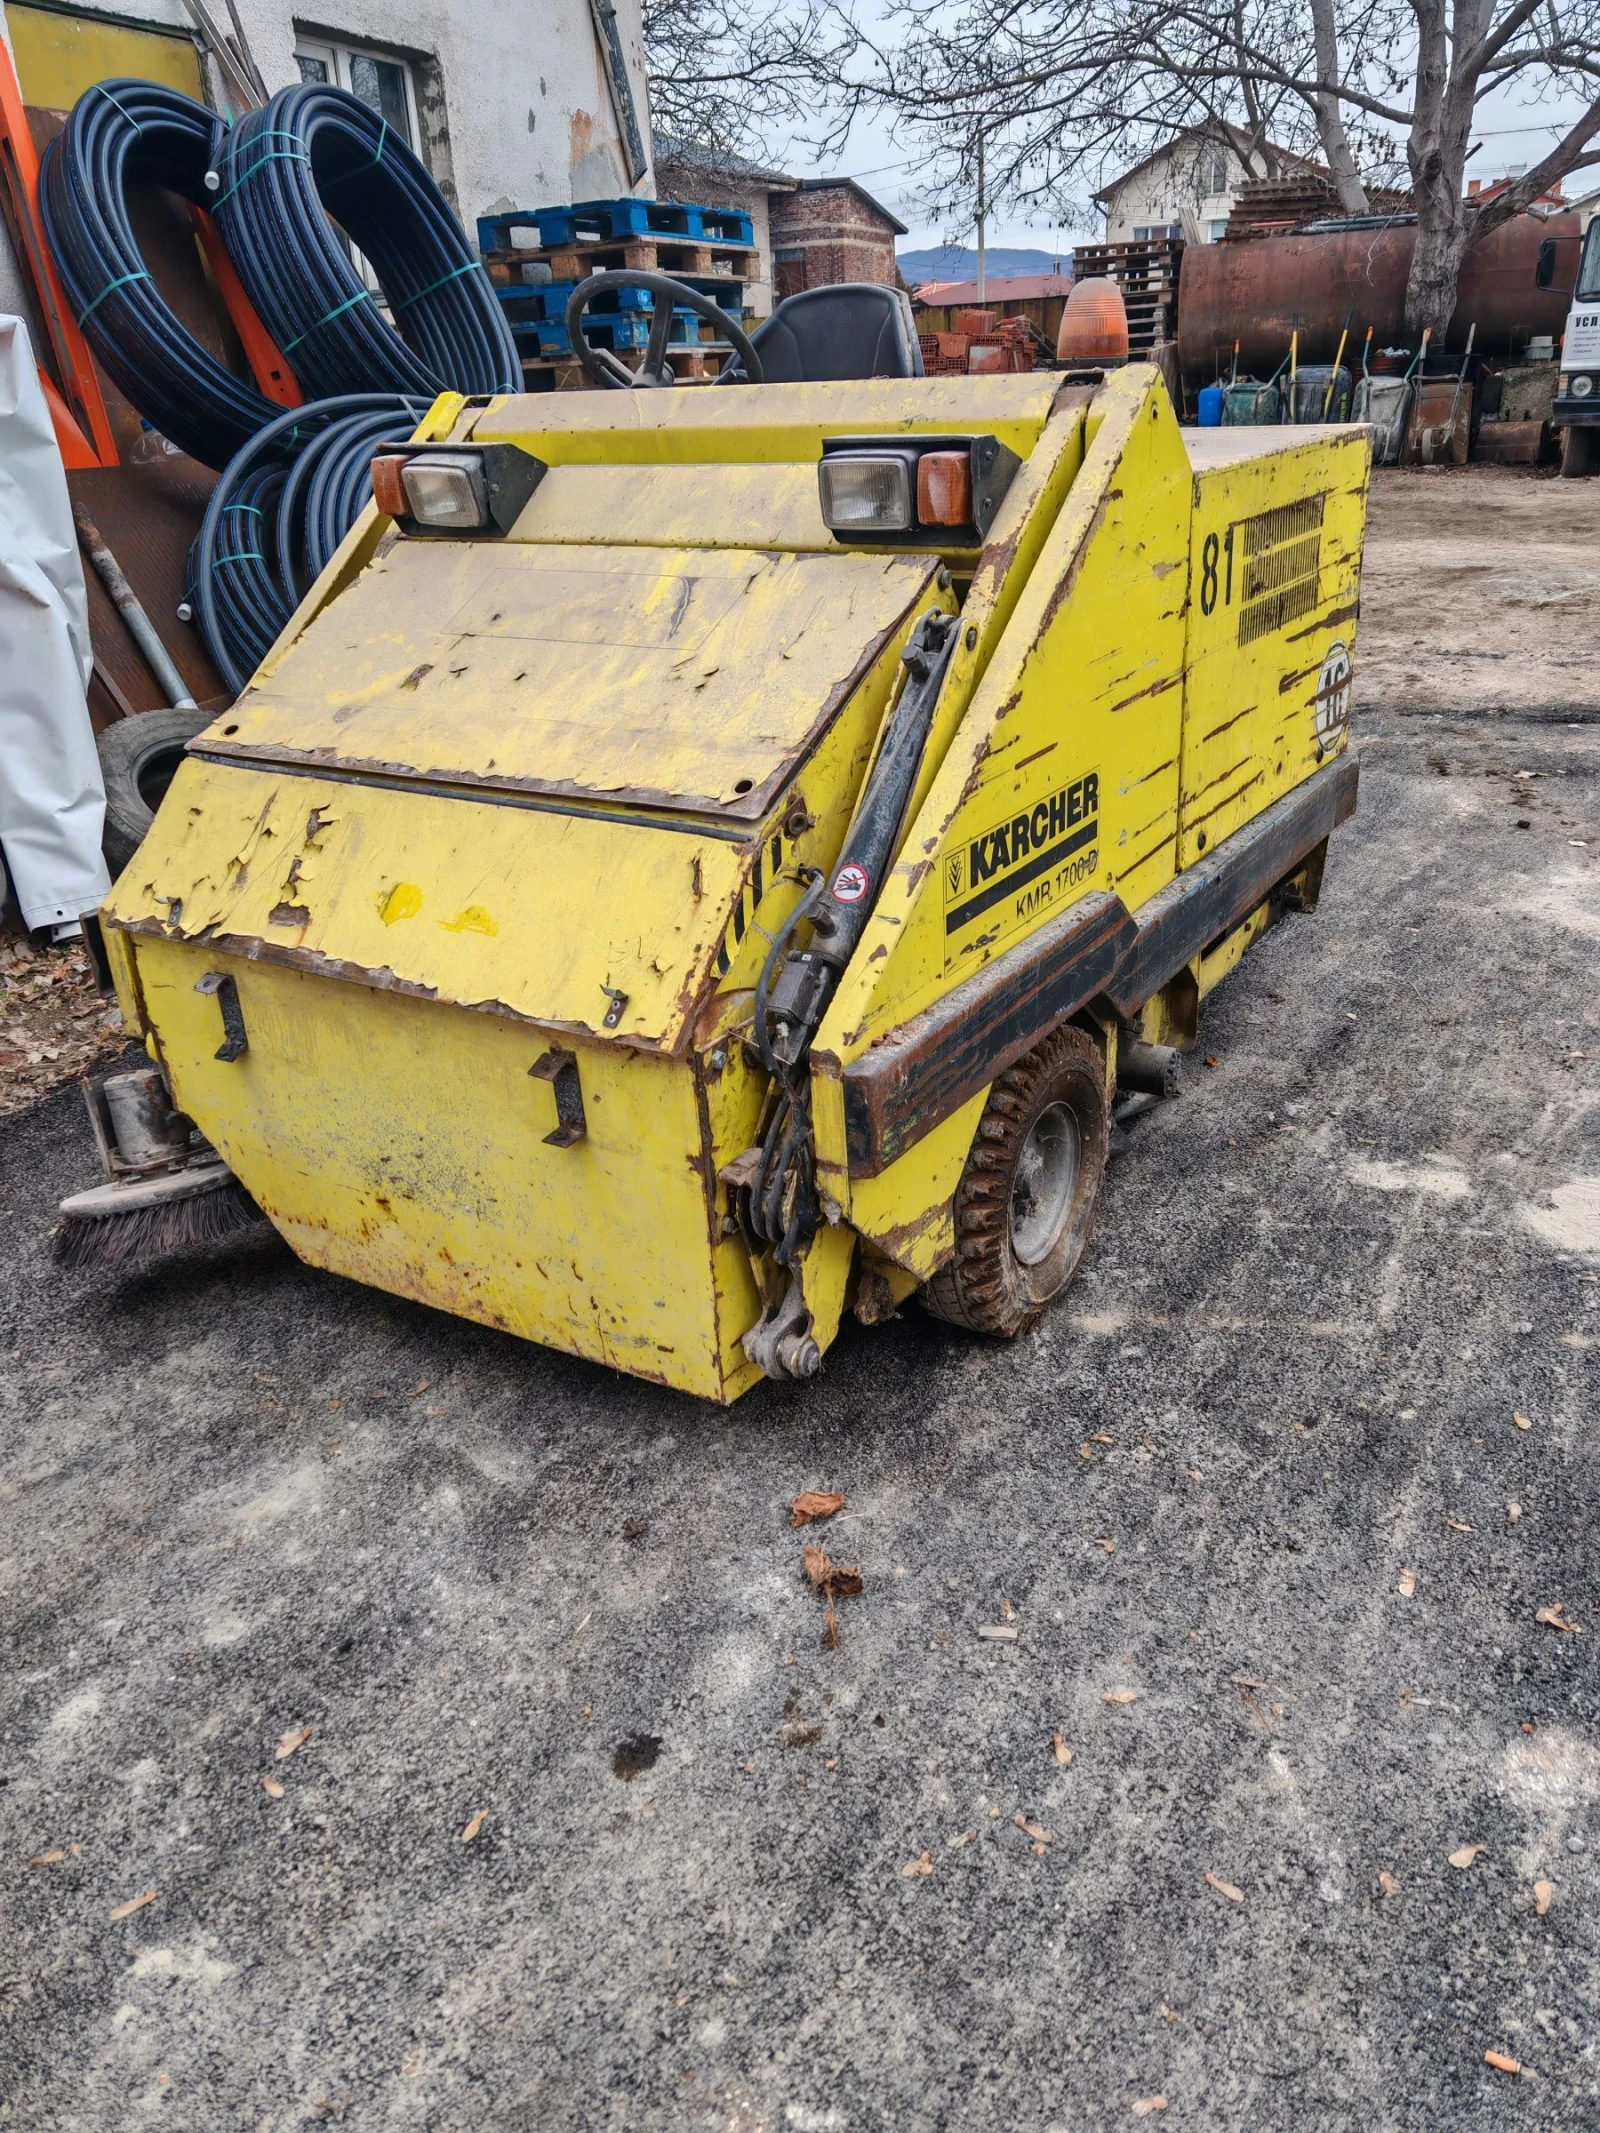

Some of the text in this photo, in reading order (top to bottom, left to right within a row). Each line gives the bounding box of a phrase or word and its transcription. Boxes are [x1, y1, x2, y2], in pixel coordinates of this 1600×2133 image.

[1575, 316, 1600, 327] УСЛ
[1201, 525, 1234, 616] 81
[970, 772, 1099, 889] KÄRCHER
[1016, 880, 1053, 920] KMR
